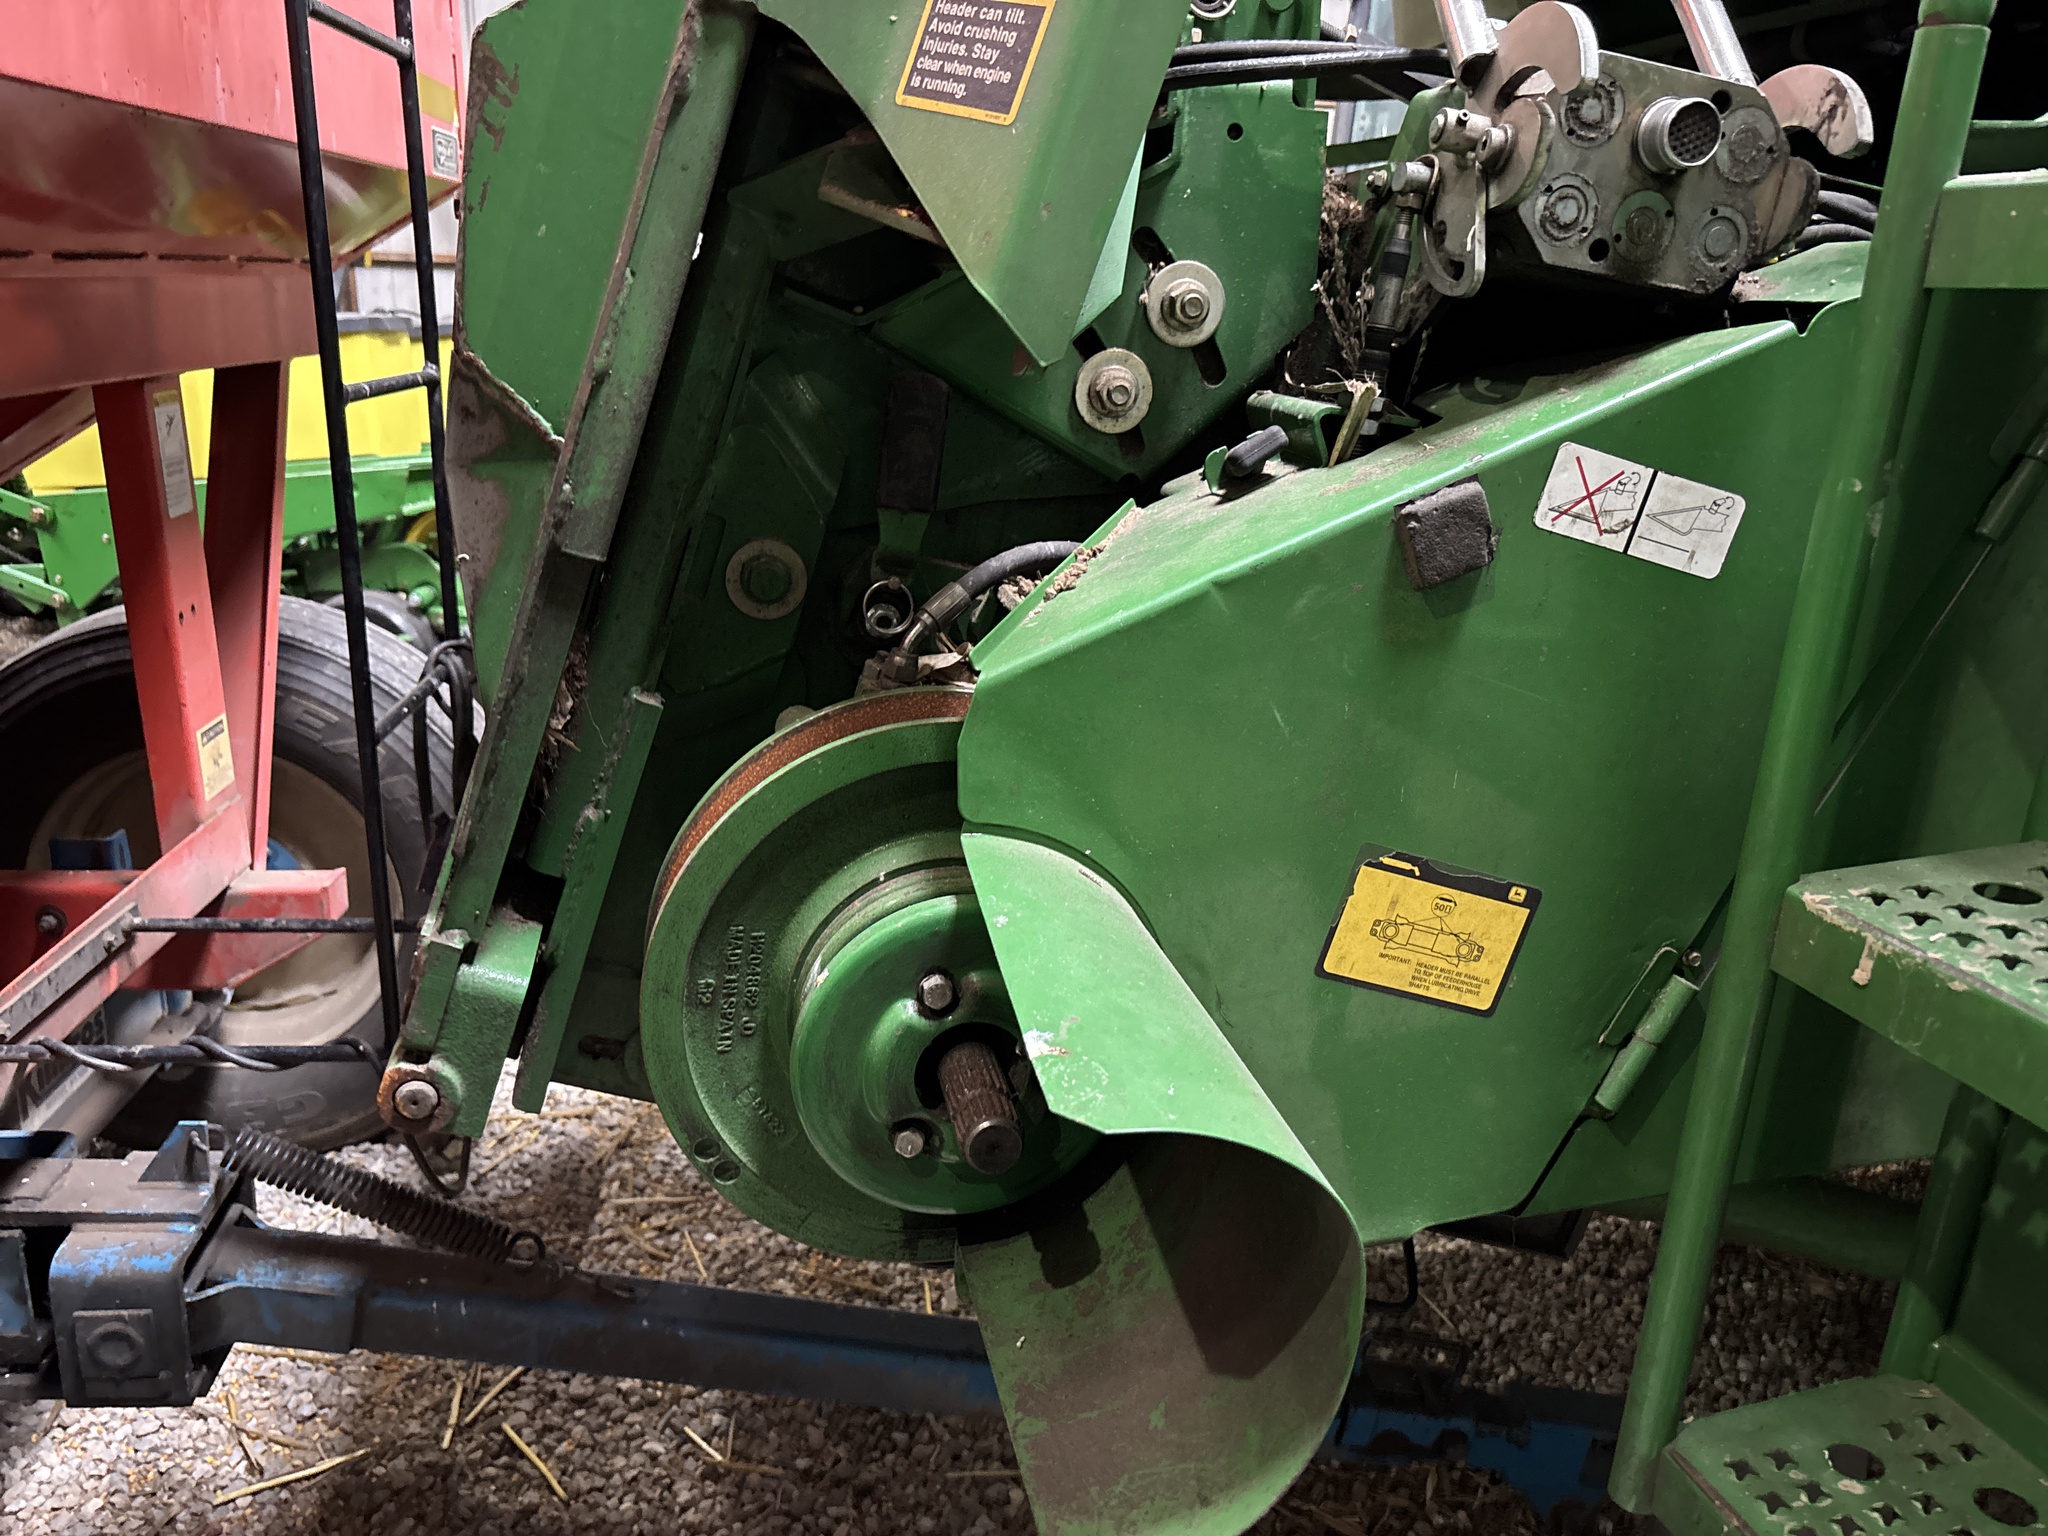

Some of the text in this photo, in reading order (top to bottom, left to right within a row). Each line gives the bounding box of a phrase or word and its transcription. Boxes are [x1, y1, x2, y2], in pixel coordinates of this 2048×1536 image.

[934, 0, 1026, 25] Header can tilt.
[928, 17, 1018, 47] Avoid crushing
[922, 36, 1001, 65] injuries. Stay
[916, 55, 1012, 85] clear when engine
[910, 72, 967, 99] is running.
[1379, 952, 1412, 965] IMPORTANT:
[1414, 967, 1422, 975] TO
[1423, 970, 1434, 978] TOP
[1442, 975, 1483, 990] FEEDERHOUSE
[1416, 961, 1491, 985] HEADER MUST BE PARALLEL
[717, 925, 744, 1053] MADE IN SPAIN
[1409, 981, 1430, 991] SHAFTS
[1411, 975, 1481, 997] WHEN LUBRICATING DRIVE
